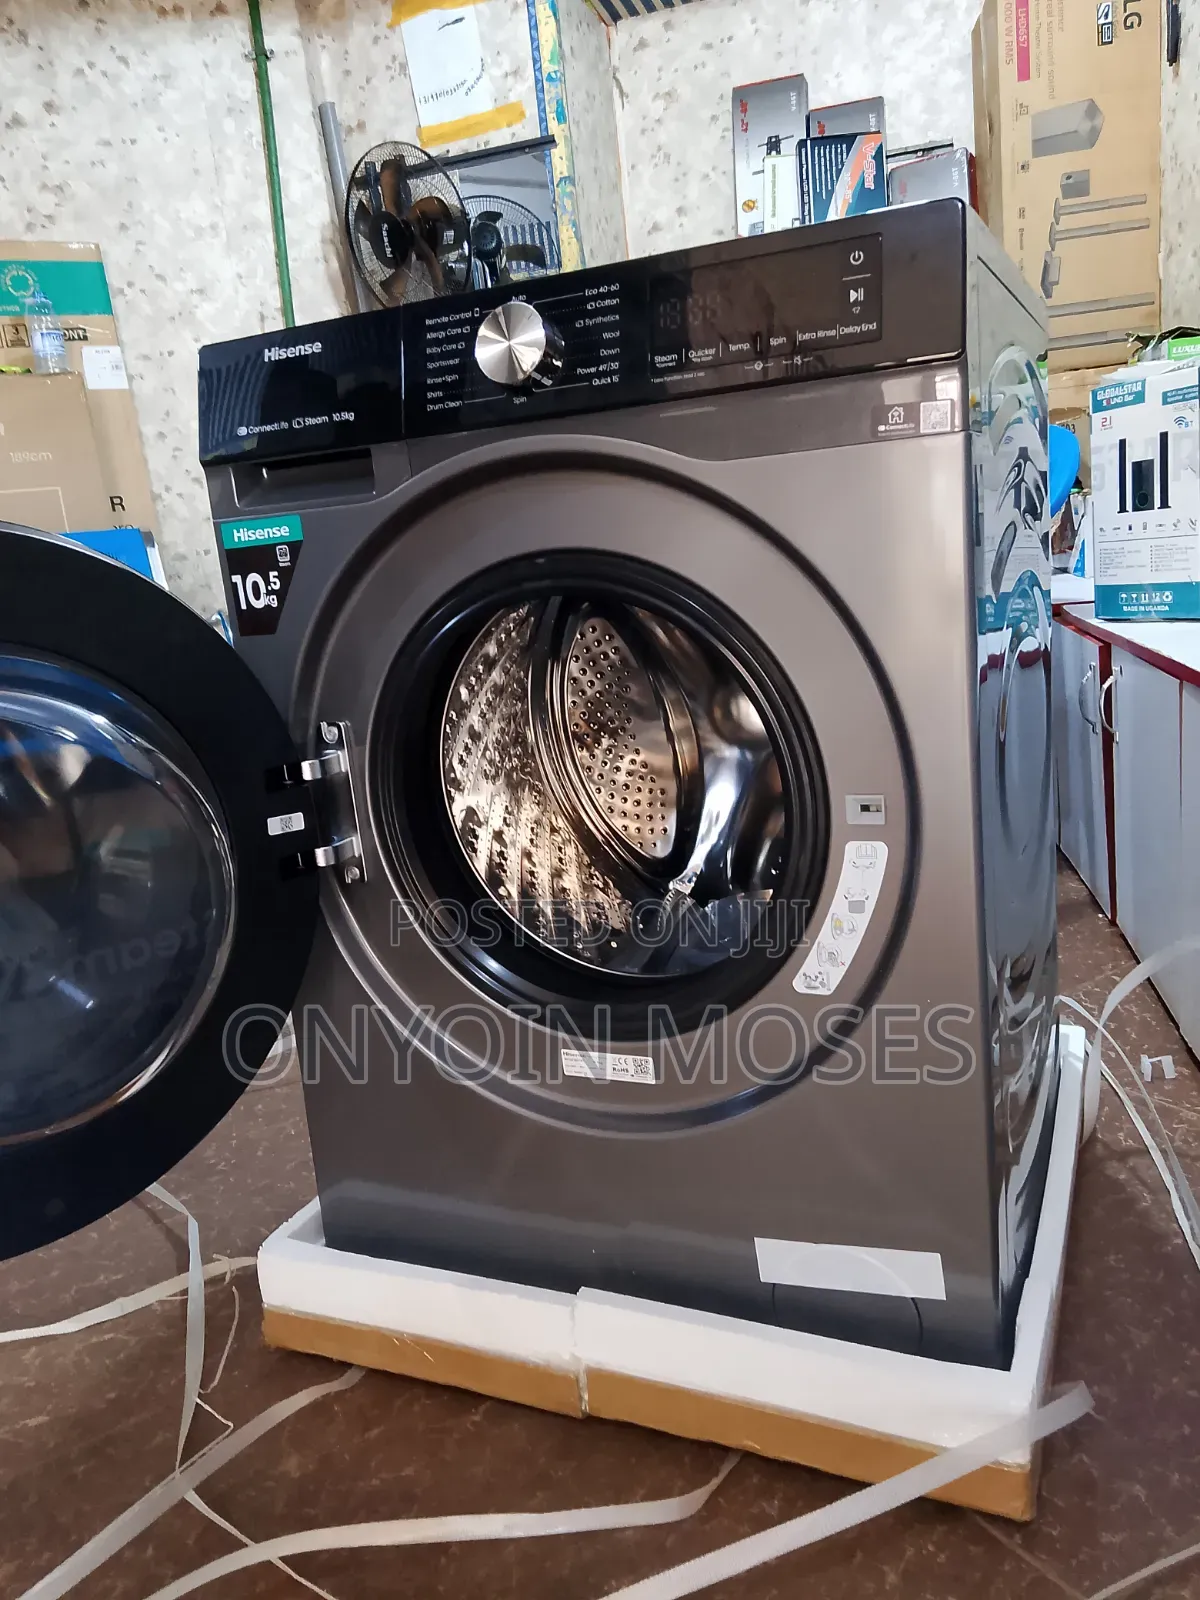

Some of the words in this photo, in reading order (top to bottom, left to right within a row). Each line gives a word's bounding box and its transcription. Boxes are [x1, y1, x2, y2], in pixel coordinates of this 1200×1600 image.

[1123, 0, 1142, 31] LG
[862, 142, 876, 190] V-Star
[585, 287, 598, 297] Eco
[599, 283, 620, 294] 40-60
[596, 298, 620, 309] Cotton
[425, 315, 448, 327] Remote
[450, 311, 472, 322] Control
[585, 314, 620, 327] Synthetics
[426, 329, 446, 341] Allergy
[447, 327, 462, 336] Care
[602, 330, 620, 340] Wool
[798, 331, 816, 342] Extra
[817, 328, 837, 339] Rinse
[839, 325, 861, 337] Delay
[862, 322, 877, 333] End
[769, 335, 787, 347] Spin
[264, 341, 322, 363] Hisense
[426, 345, 441, 356] Baby
[442, 343, 457, 352] Care
[599, 347, 620, 357] Down
[688, 347, 716, 359] Quicker
[426, 357, 460, 369] Sportswear
[654, 353, 678, 363] Steam
[576, 366, 597, 376] Power
[592, 377, 611, 387] Quick
[426, 390, 443, 399] Shirts
[426, 401, 443, 412] Drum
[444, 399, 463, 409] Clean
[512, 396, 527, 406] Spin
[304, 415, 329, 427] Steam
[332, 411, 355, 423] 10.5kg
[9, 451, 53, 463] 189cm
[109, 495, 126, 512] R
[233, 525, 290, 543] Hisense
[264, 594, 278, 608] kg
